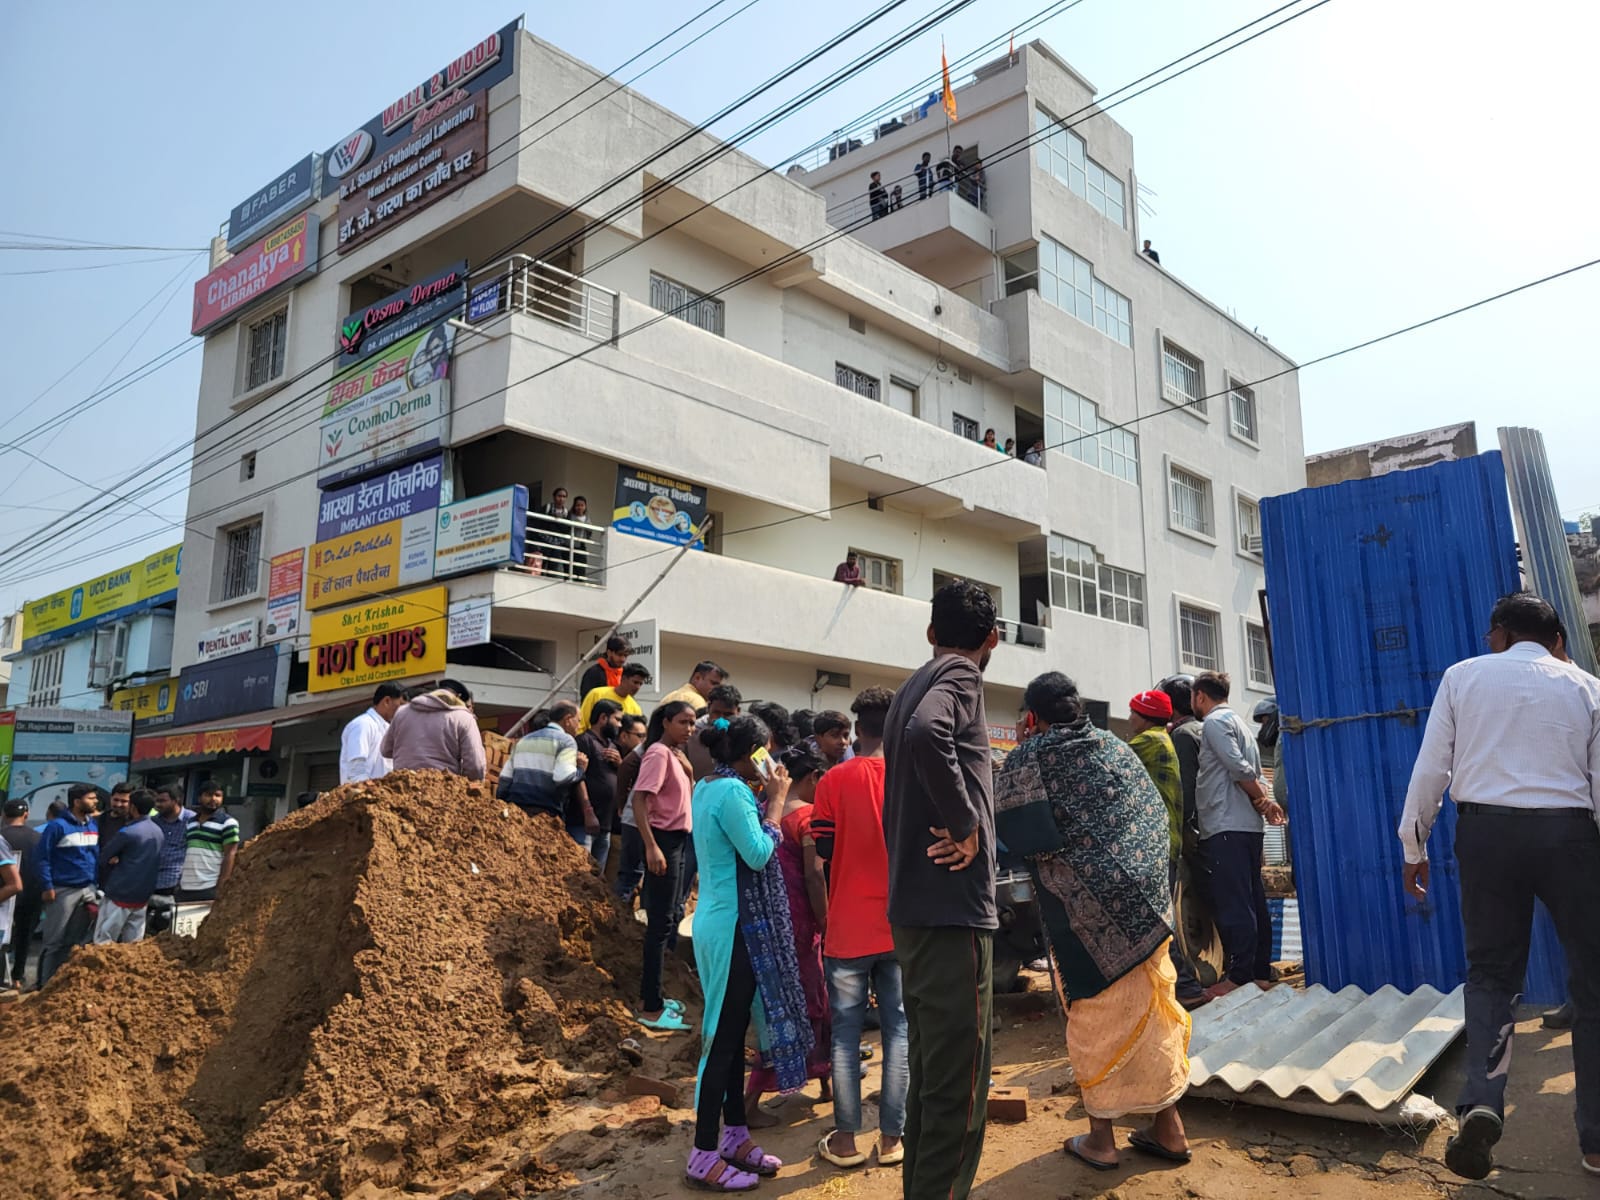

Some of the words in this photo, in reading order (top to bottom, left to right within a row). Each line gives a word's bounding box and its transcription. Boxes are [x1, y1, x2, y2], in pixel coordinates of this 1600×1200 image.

[382, 85, 423, 128] WALL
[430, 73, 442, 96] 2
[447, 33, 499, 84] WOOD
[389, 128, 432, 168] Pathological
[434, 104, 475, 140] Laboratory
[420, 148, 441, 168] Centre
[250, 172, 297, 213] FABER
[376, 192, 403, 219] शरण
[405, 180, 423, 201] का
[453, 149, 473, 172] घर
[207, 244, 289, 305] Chanakya
[220, 274, 268, 312] LIBRARY
[364, 299, 404, 329] Cosmo
[410, 272, 456, 306] Derma
[348, 393, 431, 435] CosmoDerma
[320, 494, 355, 523] आस्था
[358, 482, 384, 511] डेंटल
[340, 511, 377, 533] IMPLANT
[379, 500, 411, 522] CENTRE
[336, 545, 352, 560] Lal
[89, 584, 105, 597] UCO
[108, 570, 132, 590] BANK
[342, 611, 361, 627] Shri
[365, 603, 405, 622] Krishna
[354, 625, 370, 635] South
[371, 621, 389, 631] Indian
[205, 637, 228, 654] DENTAL
[230, 629, 252, 646] CLINIC
[317, 639, 358, 677] HOT
[364, 626, 426, 667] CHIPS
[192, 679, 209, 699] SBI
